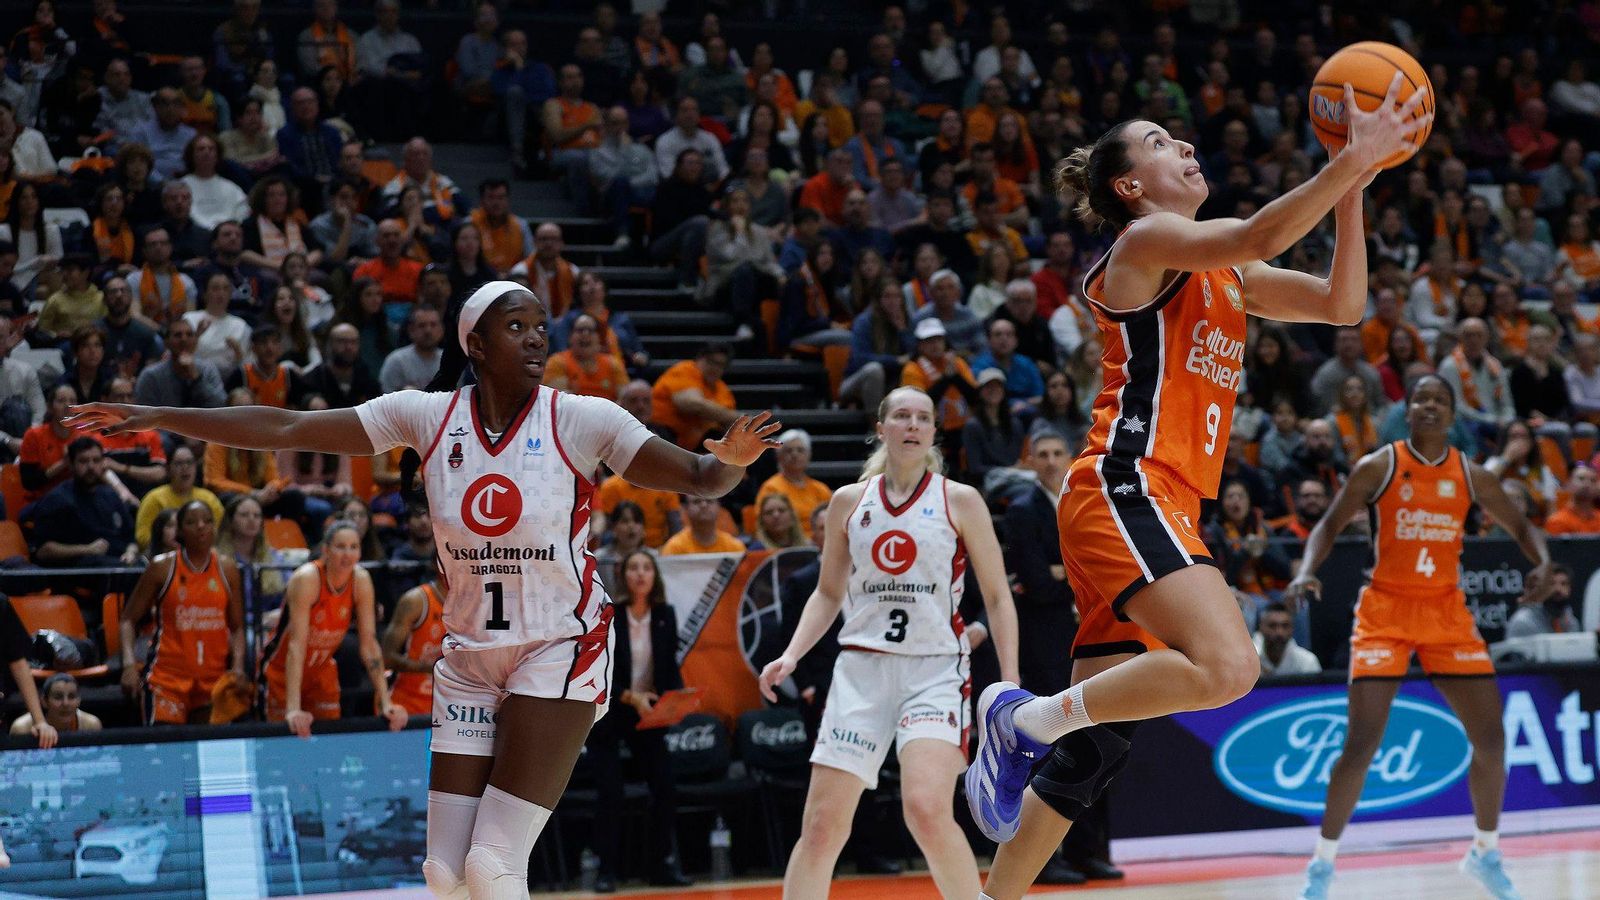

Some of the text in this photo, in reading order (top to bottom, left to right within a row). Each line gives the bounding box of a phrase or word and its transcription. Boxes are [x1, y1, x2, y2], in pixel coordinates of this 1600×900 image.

[1205, 402, 1221, 456] 9
[470, 565, 522, 575] ZARAGOZA
[1415, 547, 1437, 578] 4
[485, 581, 510, 630] 1
[884, 609, 909, 643] 3
[457, 729, 497, 739] HOTELE
[832, 728, 876, 752] Silken
[1503, 690, 1600, 785] At
